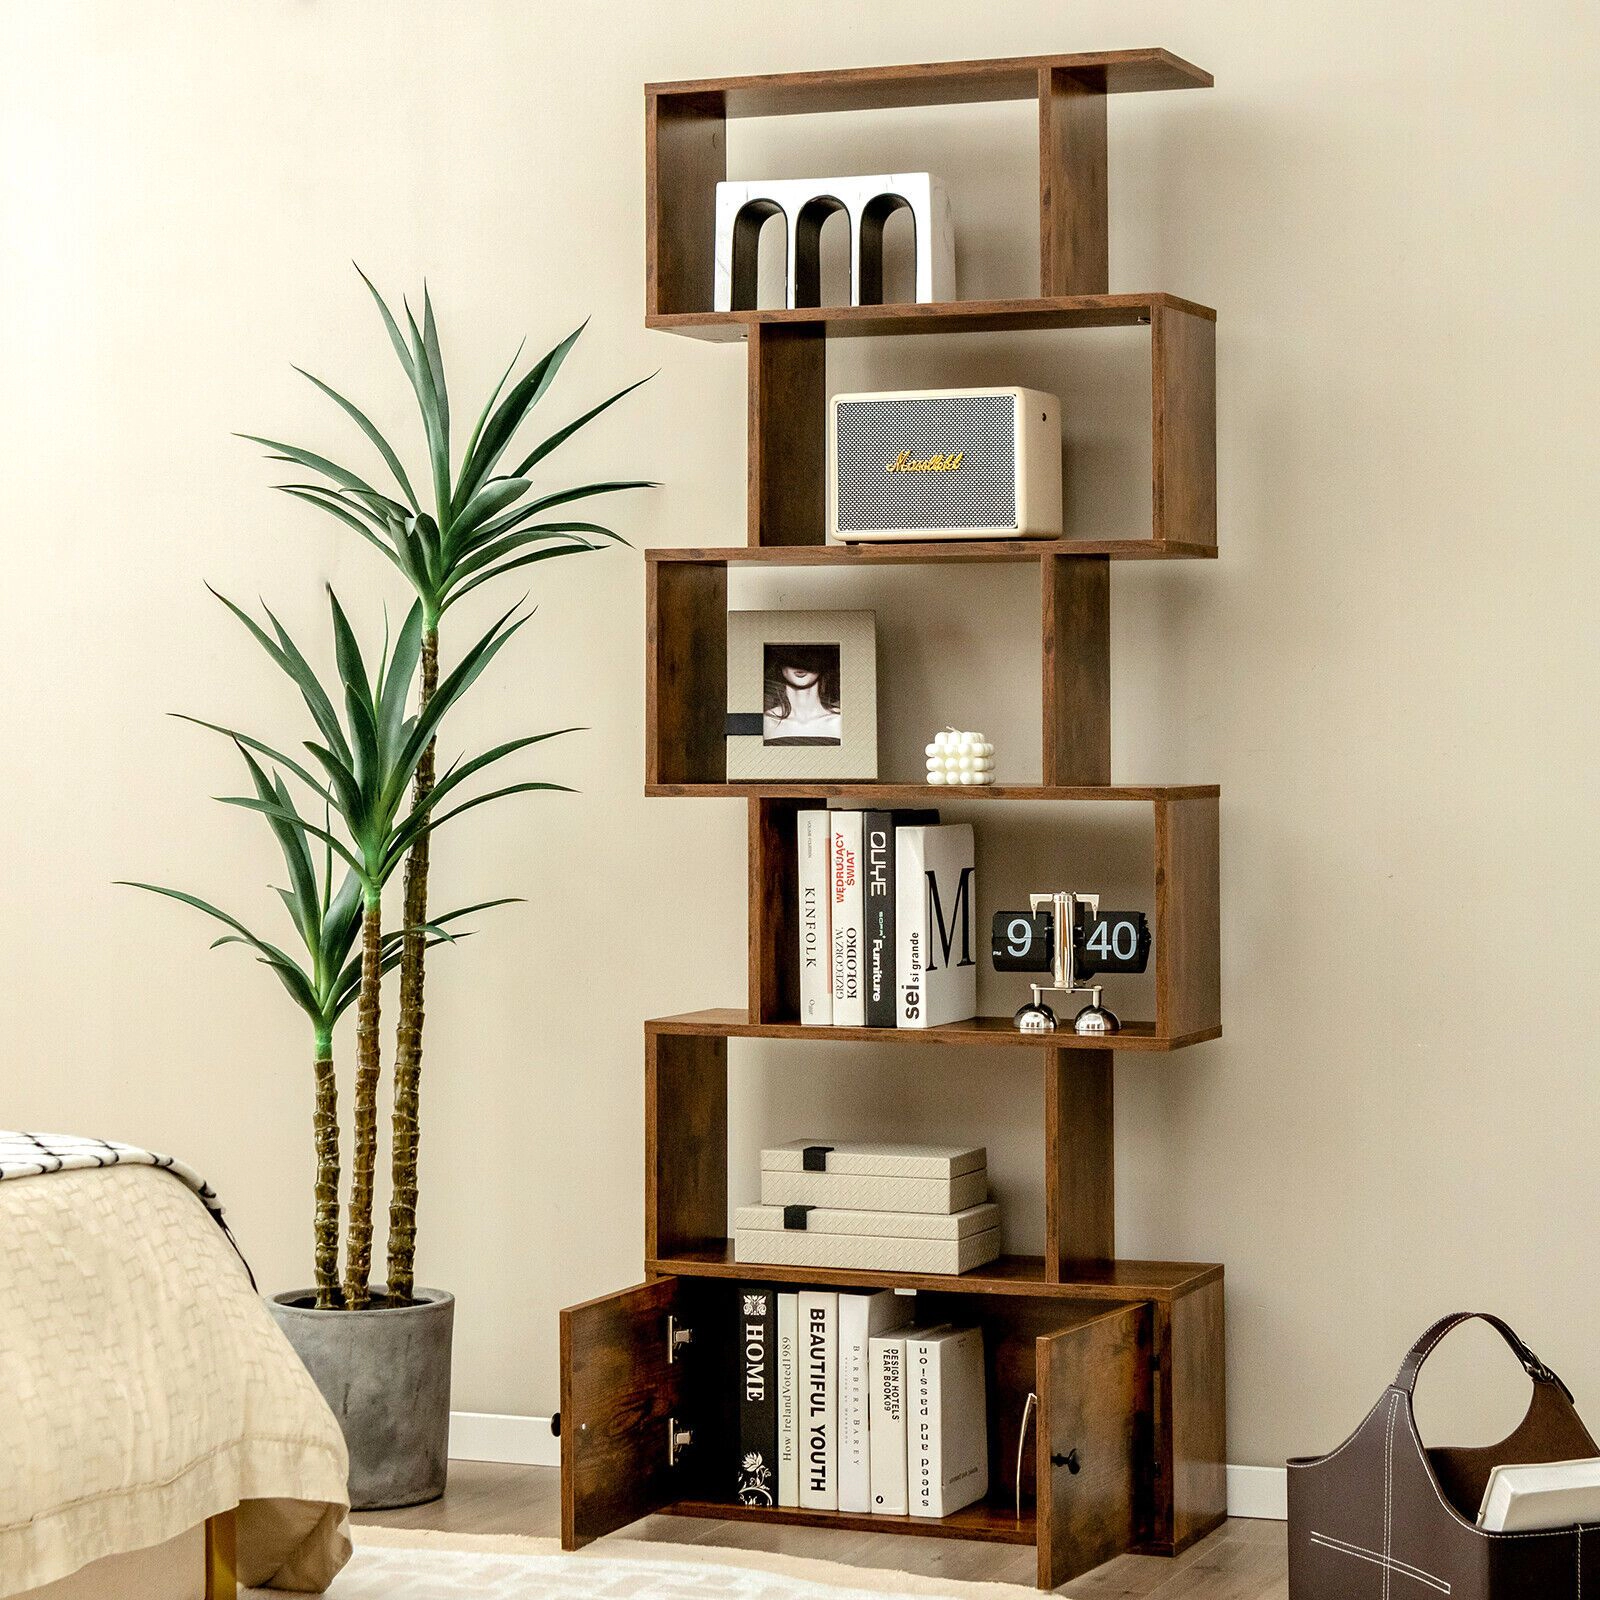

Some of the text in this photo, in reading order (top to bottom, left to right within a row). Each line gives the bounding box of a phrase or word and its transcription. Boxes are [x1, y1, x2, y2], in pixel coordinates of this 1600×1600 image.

[835, 832, 846, 903] WĘDRUJĄCY
[845, 850, 855, 886] ŚWIAT
[804, 887, 817, 968] KINFOLK
[1007, 918, 1137, 960] 9 40
[846, 927, 858, 999] KOŁODKO
[872, 938, 883, 1002] Furniture
[909, 931, 921, 969] grande
[835, 943, 844, 1000] GRZEGORZ
[901, 984, 920, 1020] sei
[745, 1323, 765, 1402] HOME
[883, 1348, 891, 1372] YEAR
[890, 1348, 899, 1382] DESIGN
[809, 1308, 826, 1492] BEAUTIFUL YOUTH
[782, 1438, 792, 1461] How
[920, 1423, 929, 1451] and
